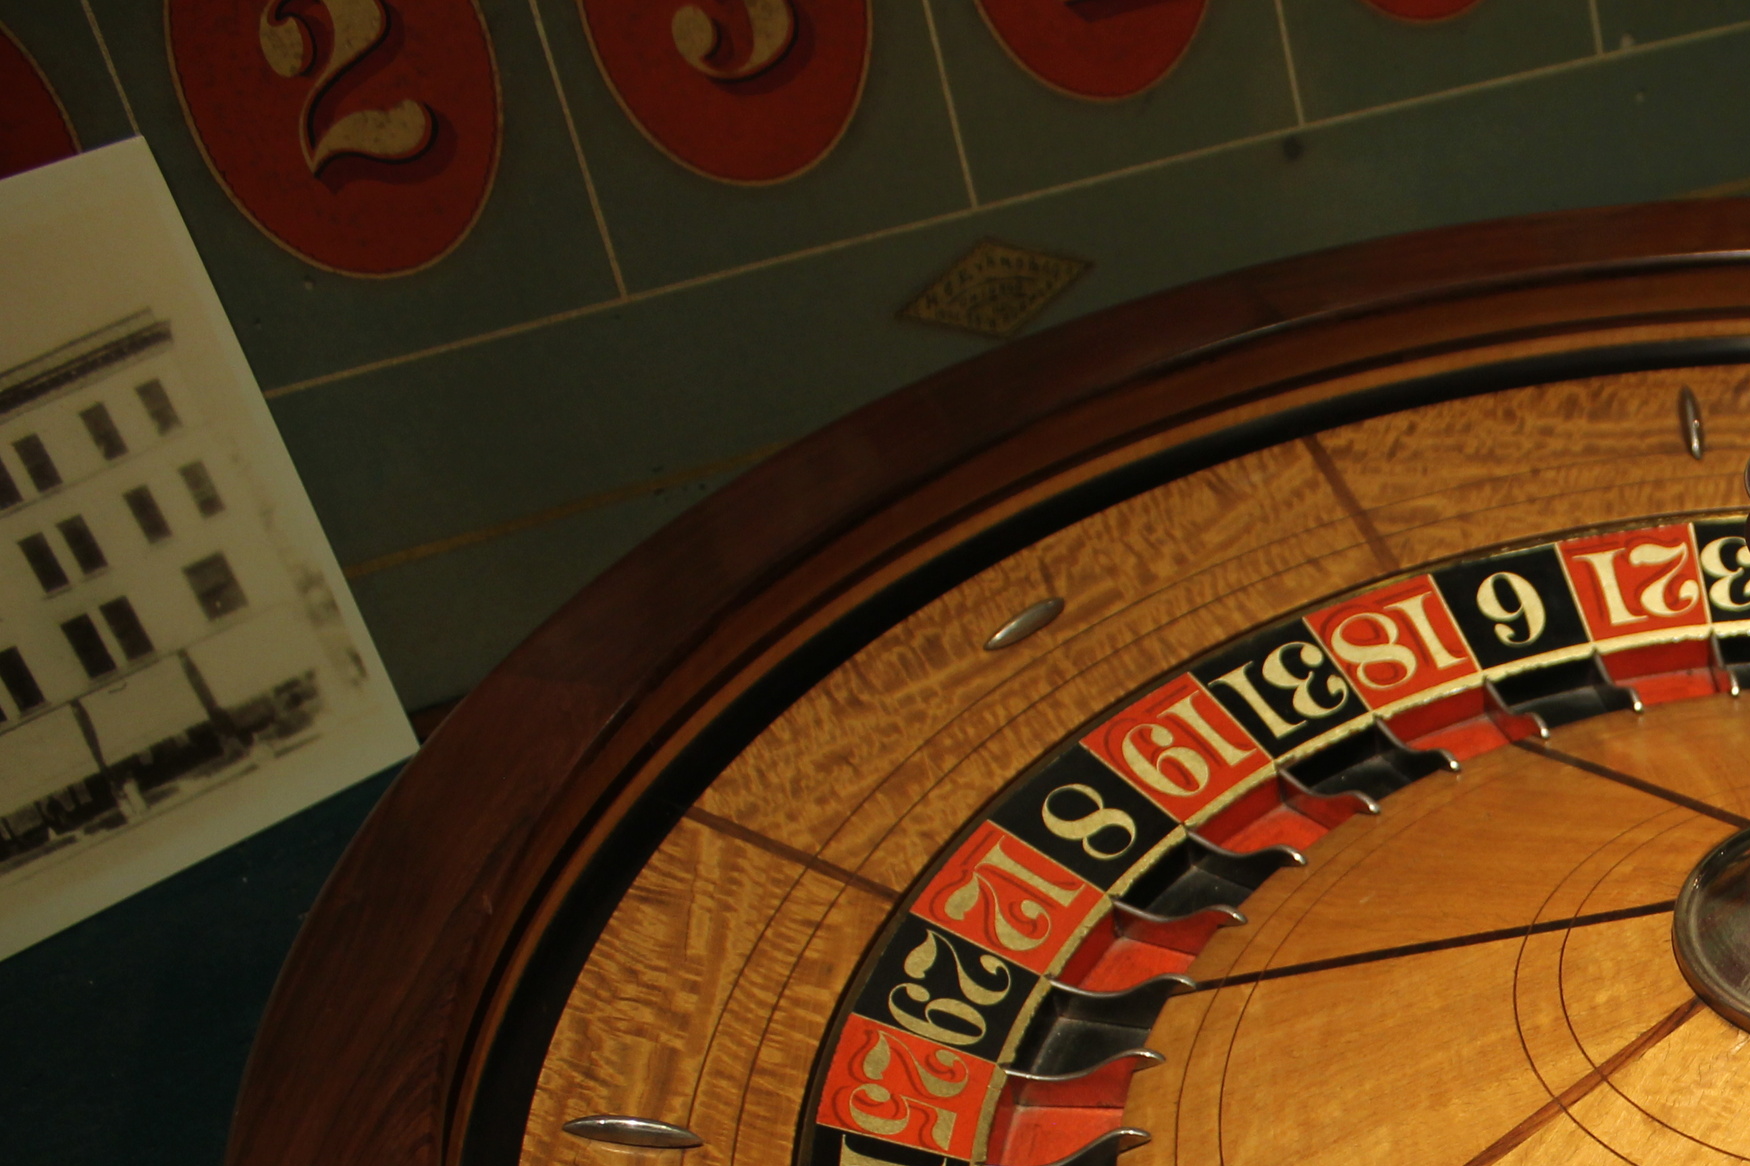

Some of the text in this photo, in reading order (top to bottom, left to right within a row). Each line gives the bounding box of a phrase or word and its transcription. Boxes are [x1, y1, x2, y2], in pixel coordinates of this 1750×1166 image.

[258, 0, 432, 174] 2
[1574, 541, 1698, 628] 21
[1208, 641, 1348, 739] 31
[1329, 592, 1468, 690] 18
[1121, 691, 1257, 797] 19
[1042, 783, 1136, 860] 8
[944, 835, 1085, 951] 12
[888, 930, 1010, 1046] 29
[849, 1030, 968, 1151] 25
